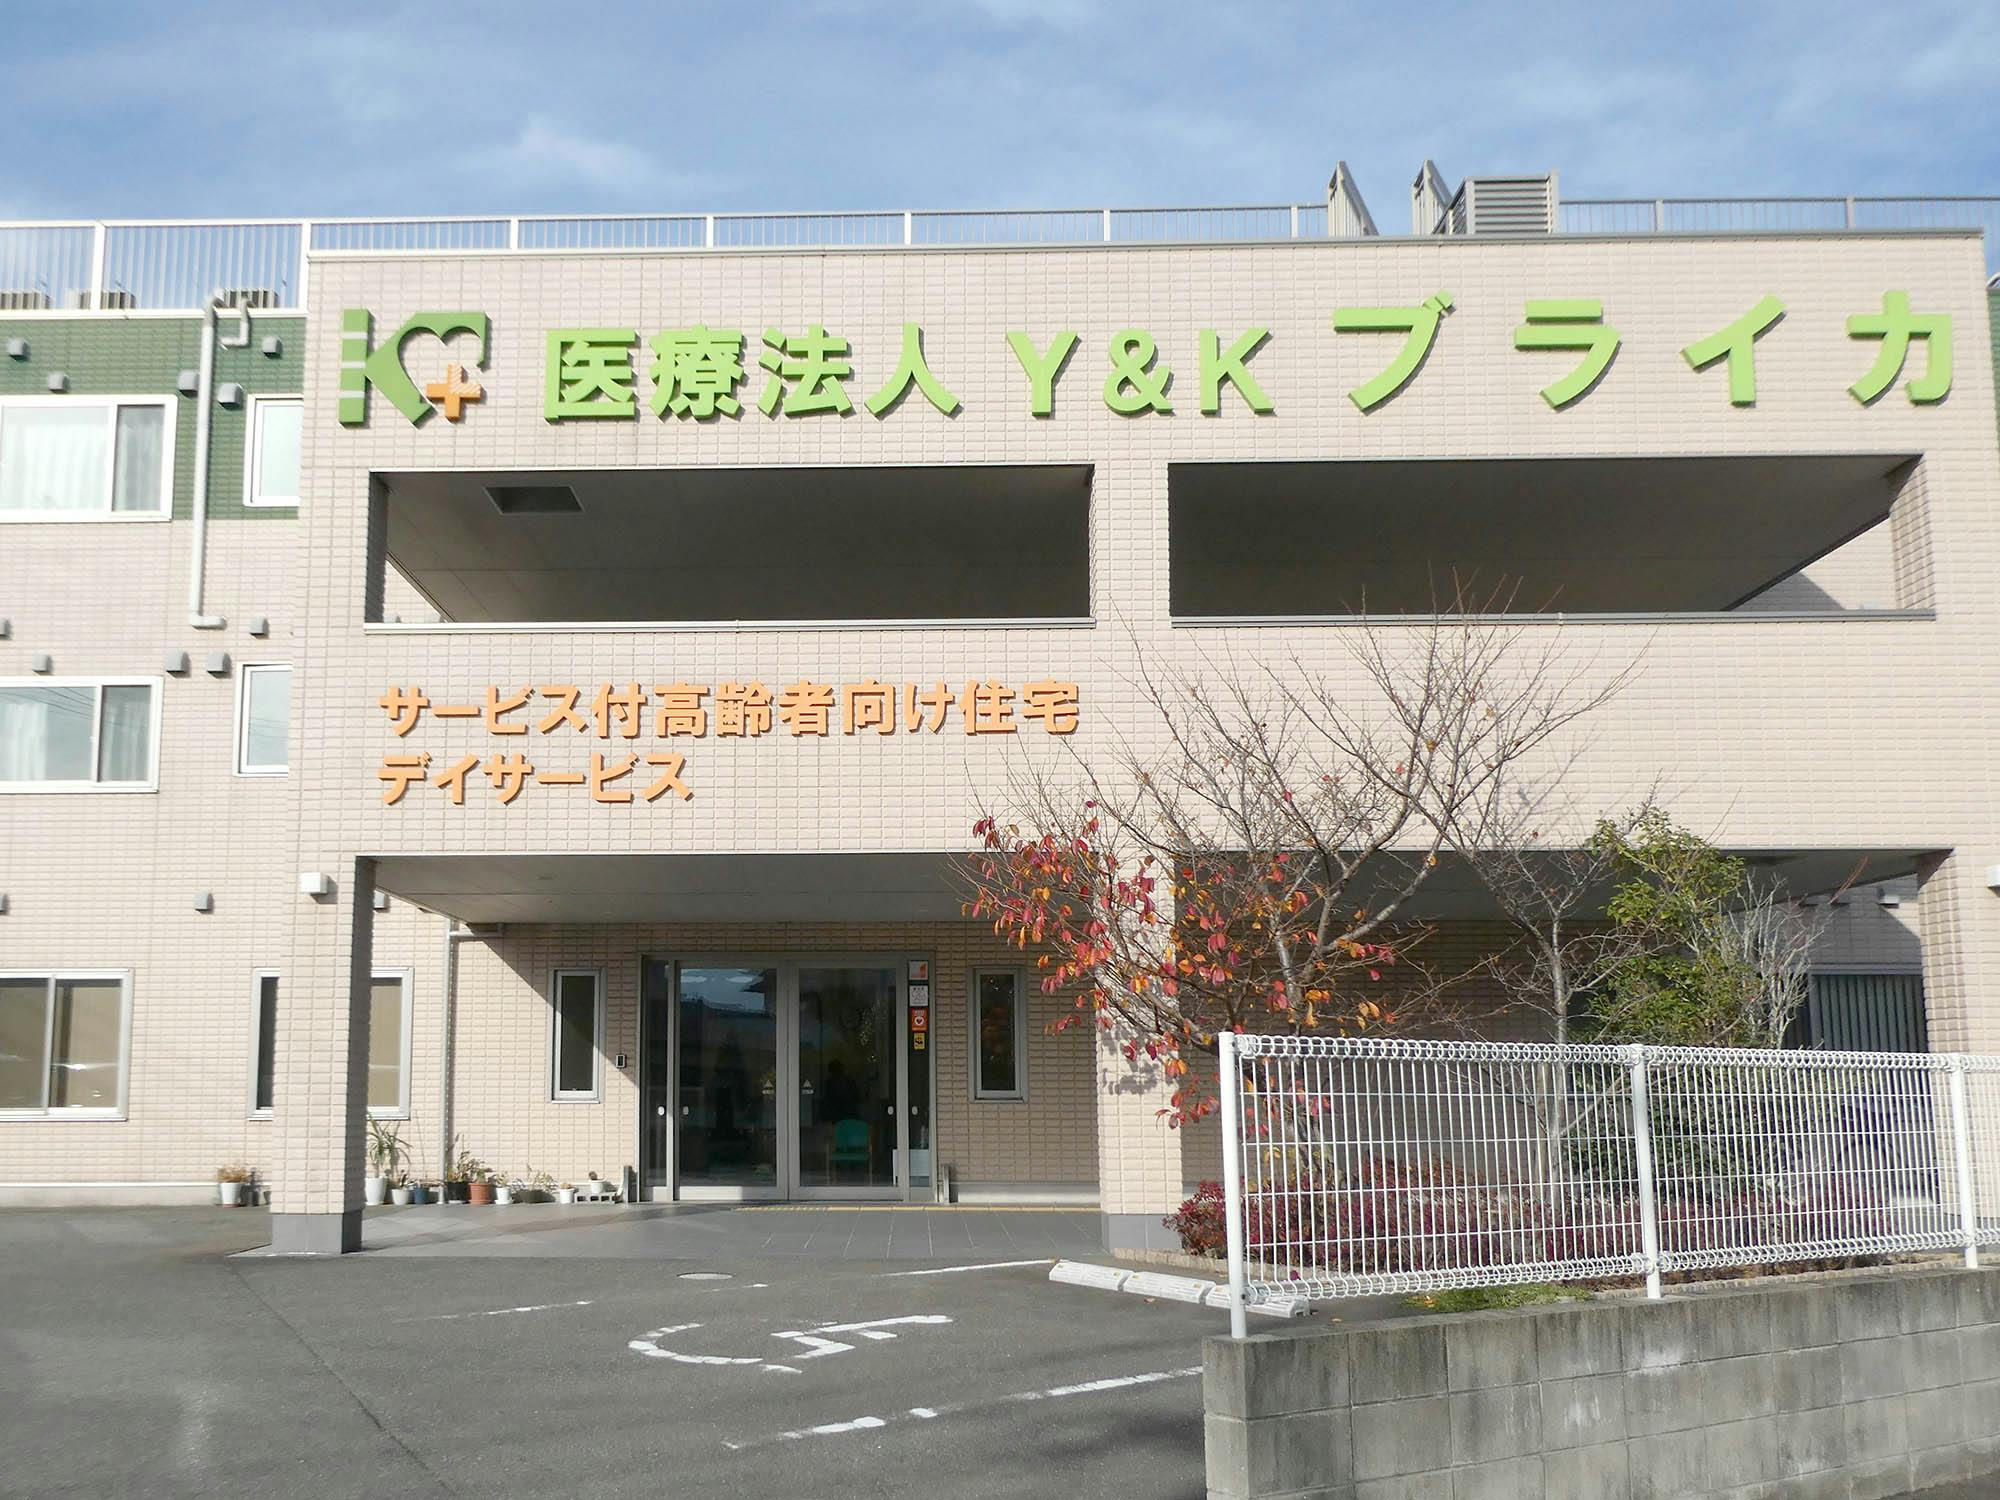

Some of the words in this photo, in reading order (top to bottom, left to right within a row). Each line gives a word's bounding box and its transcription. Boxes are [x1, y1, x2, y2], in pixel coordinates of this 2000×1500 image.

[544, 323, 960, 420] 医療法人
[1333, 291, 1953, 412] ブライカ
[380, 681, 1079, 737] サービス付高齢者向け住宅
[379, 752, 692, 804] デイサービス
